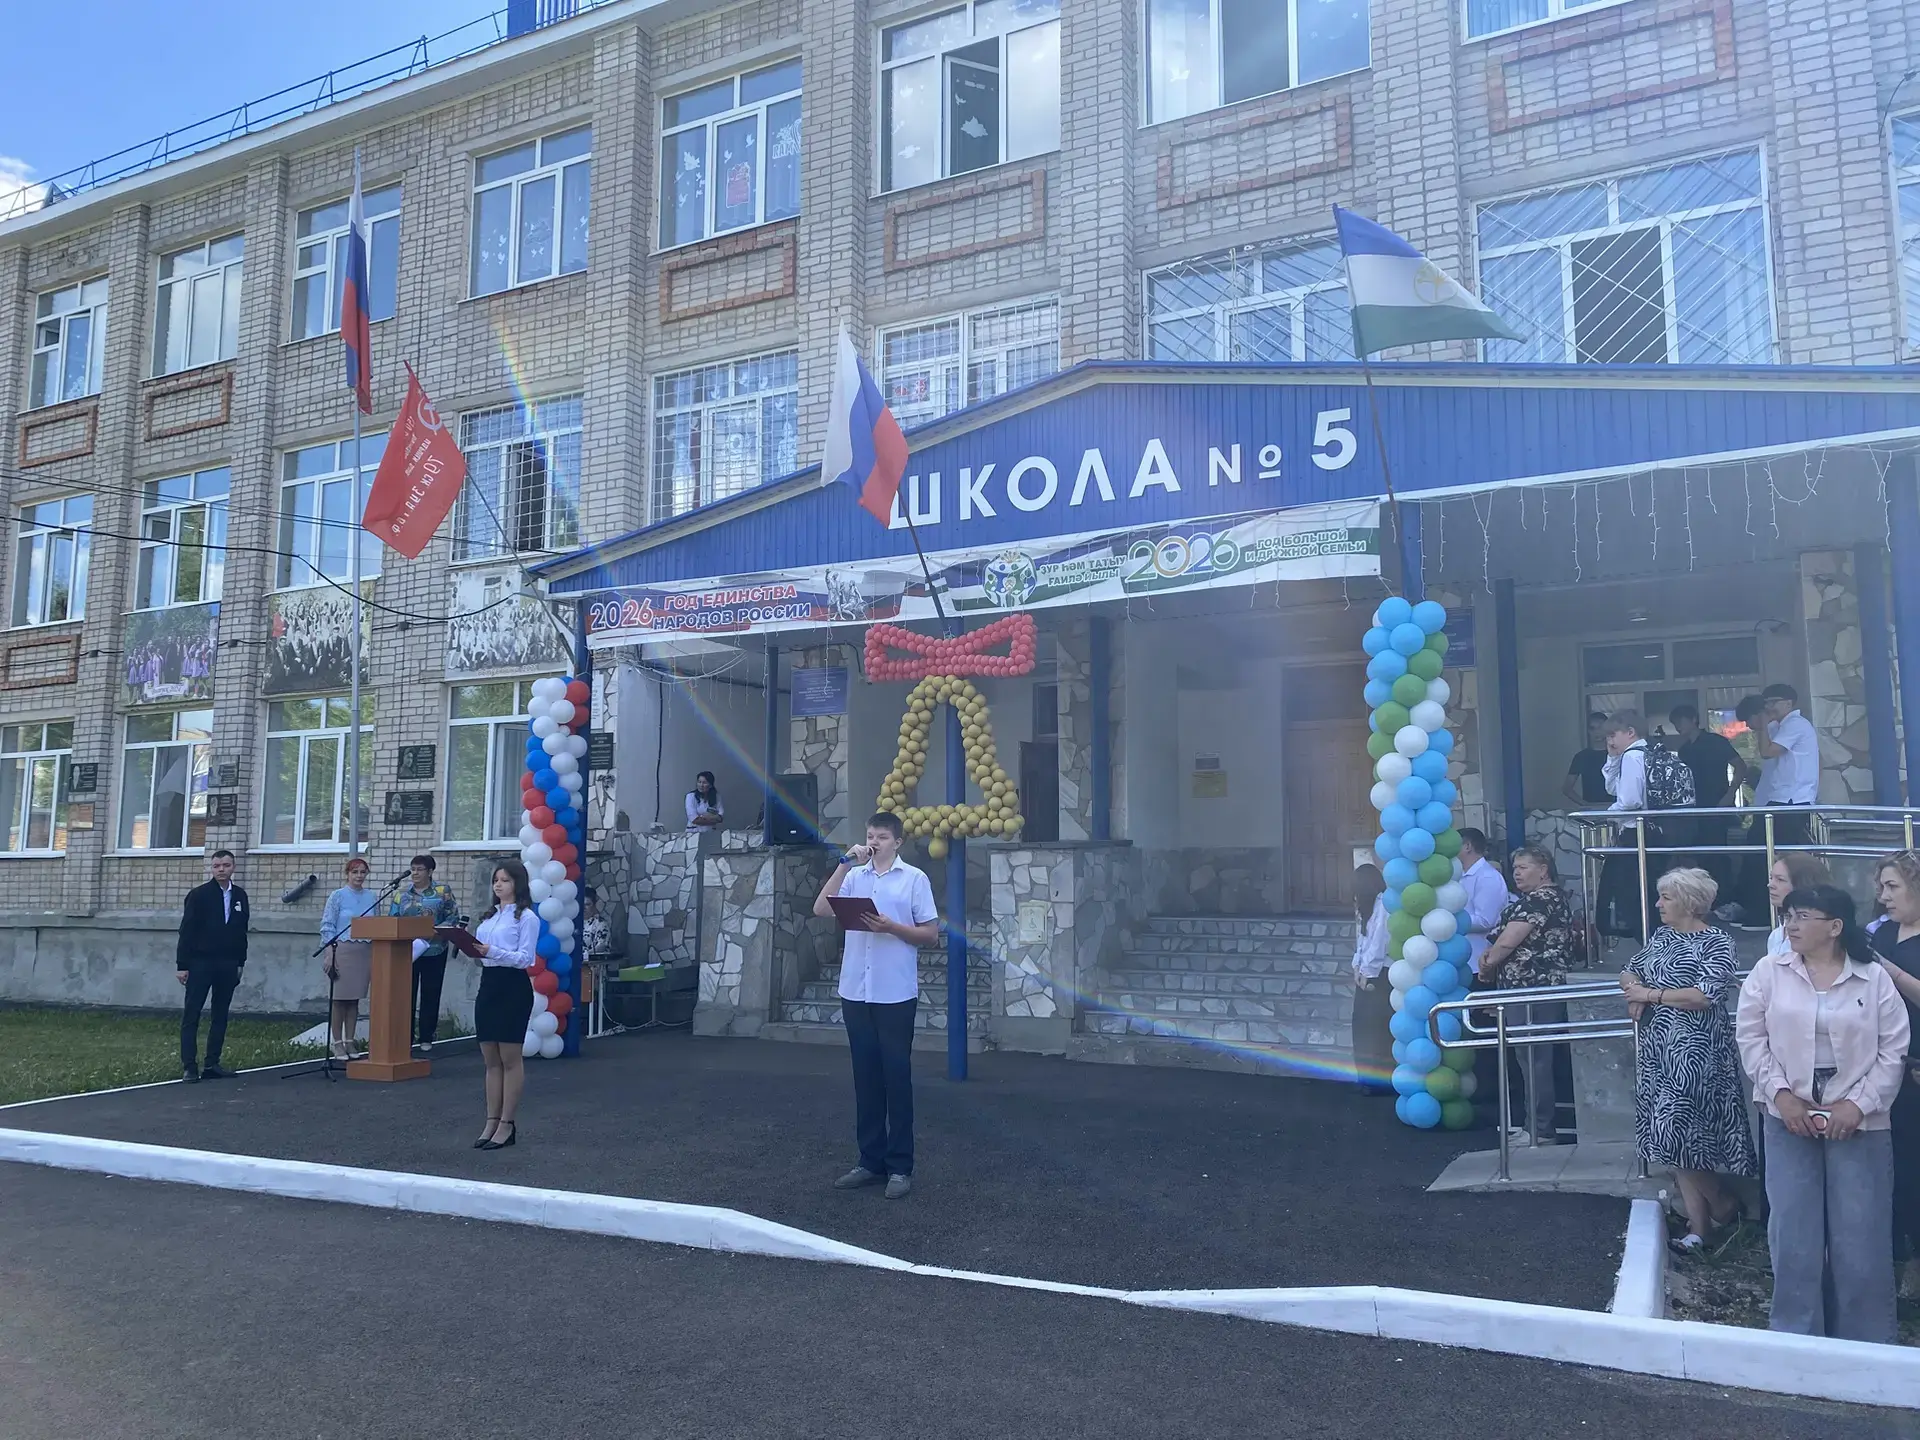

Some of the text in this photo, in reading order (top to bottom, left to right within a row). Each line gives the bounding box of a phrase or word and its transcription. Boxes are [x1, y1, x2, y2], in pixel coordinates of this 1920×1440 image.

[888, 438, 1182, 529] ШКОЛА
[1311, 407, 1358, 471] 5
[1245, 540, 1367, 562] И ДРУЖНОЙ СЕМЬИ
[1257, 529, 1348, 549] ГОД БОЛЬШОЙ
[1088, 555, 1127, 569] ТАТЫУ
[1125, 530, 1241, 583] 2026
[663, 584, 798, 610] ГОД ЕДИНСТВА
[589, 598, 654, 630] 2026
[652, 602, 812, 630] НАРОДОВ РОССИИ
